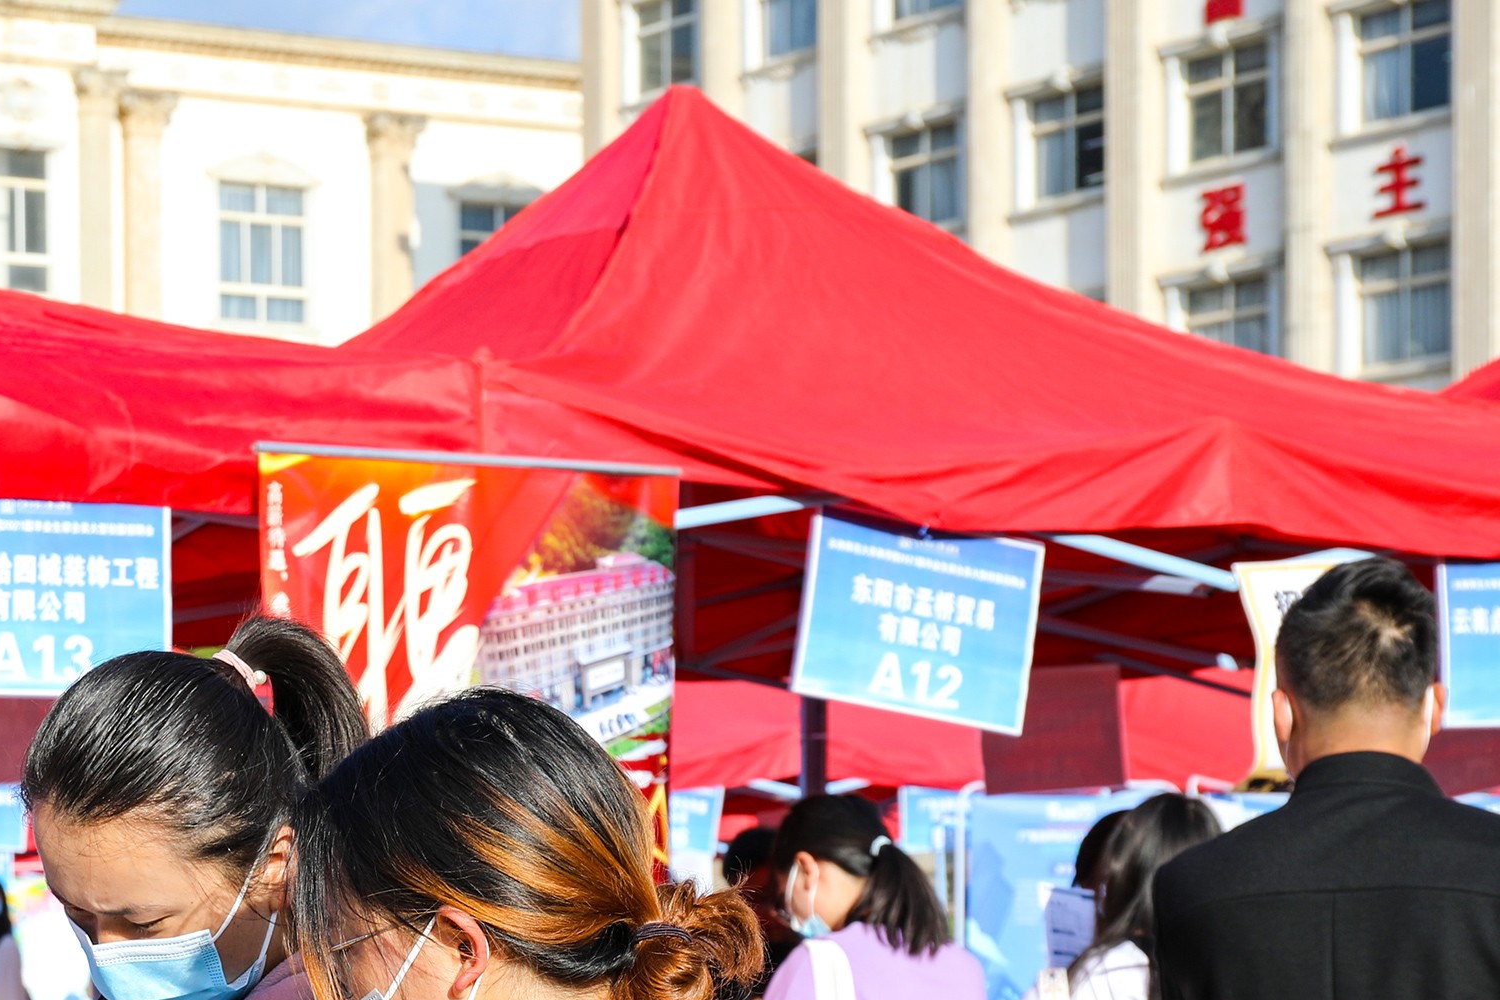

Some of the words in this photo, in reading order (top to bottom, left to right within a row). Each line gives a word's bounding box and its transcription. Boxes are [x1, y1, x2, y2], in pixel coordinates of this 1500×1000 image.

[1372, 146, 1426, 219] 主
[878, 612, 963, 657] 有限公司
[867, 652, 964, 710] A12
